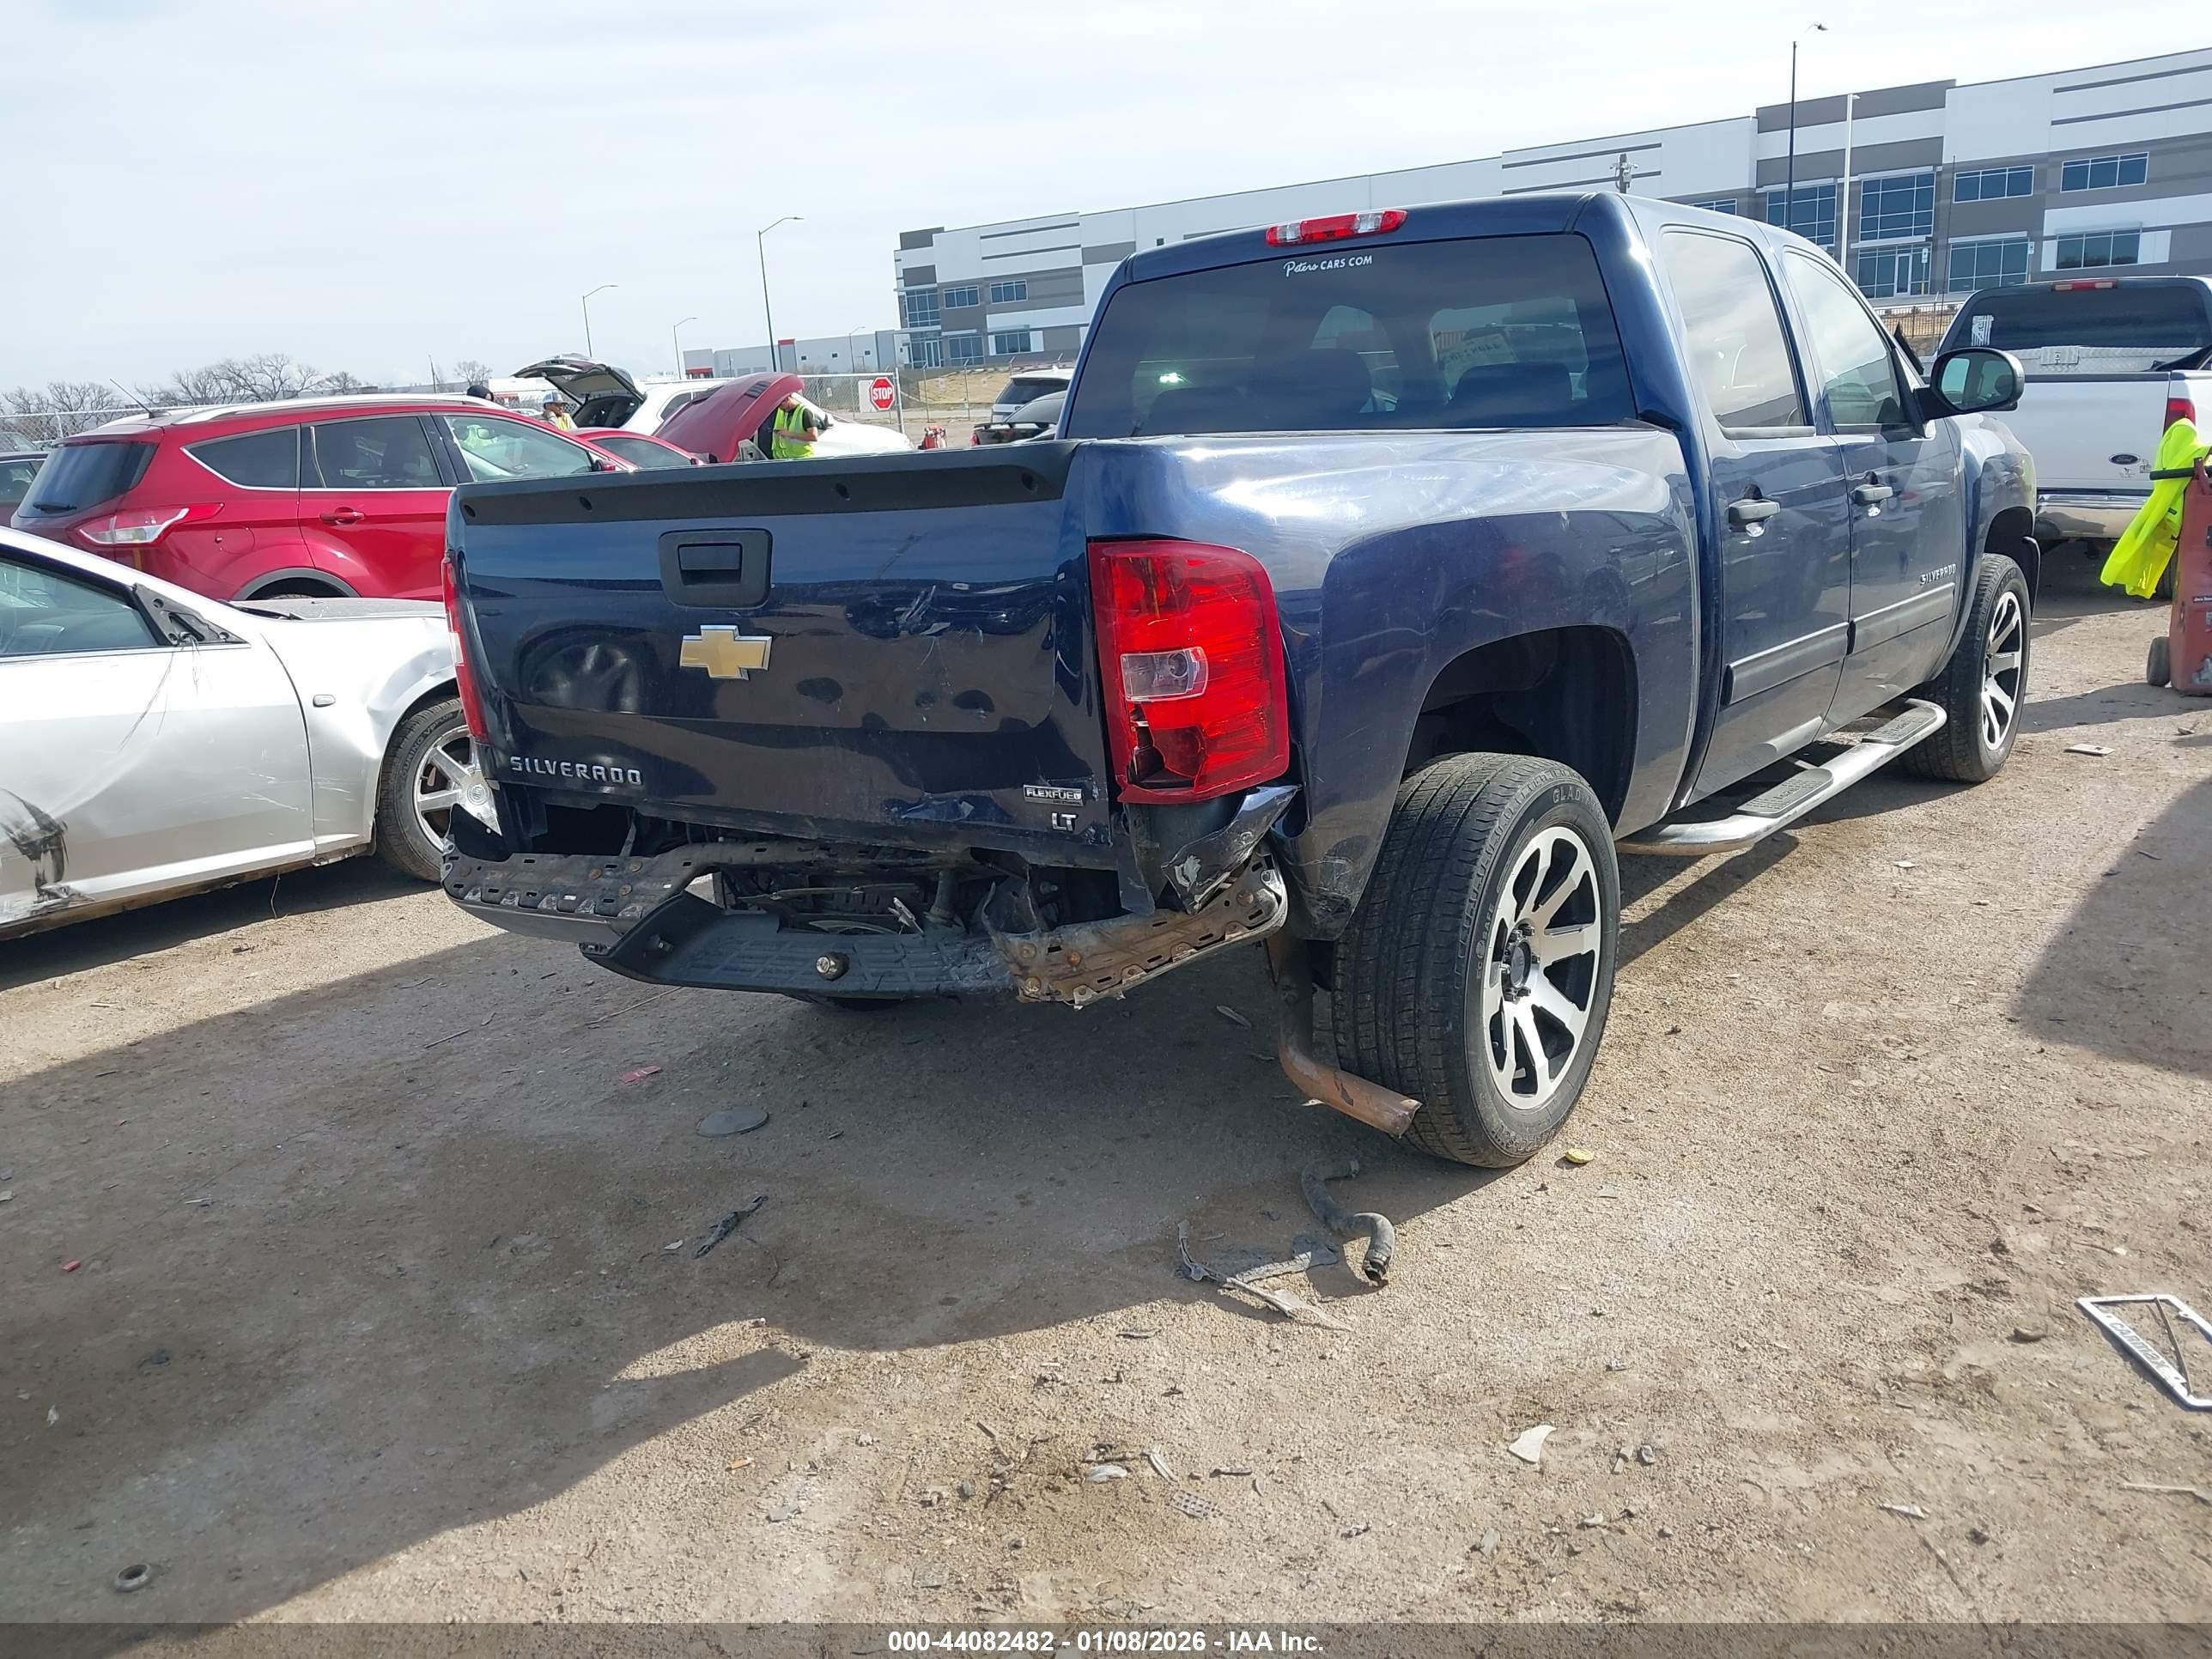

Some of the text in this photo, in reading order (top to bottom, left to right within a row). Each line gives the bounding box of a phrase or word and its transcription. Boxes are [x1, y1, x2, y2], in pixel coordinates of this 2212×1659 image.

[1283, 255, 1373, 277] Peters CARS COM
[872, 386, 893, 401] STOP
[1919, 563, 1957, 586] SILVERADO
[509, 756, 643, 787] SILVERADO
[1051, 811, 1078, 832] LT
